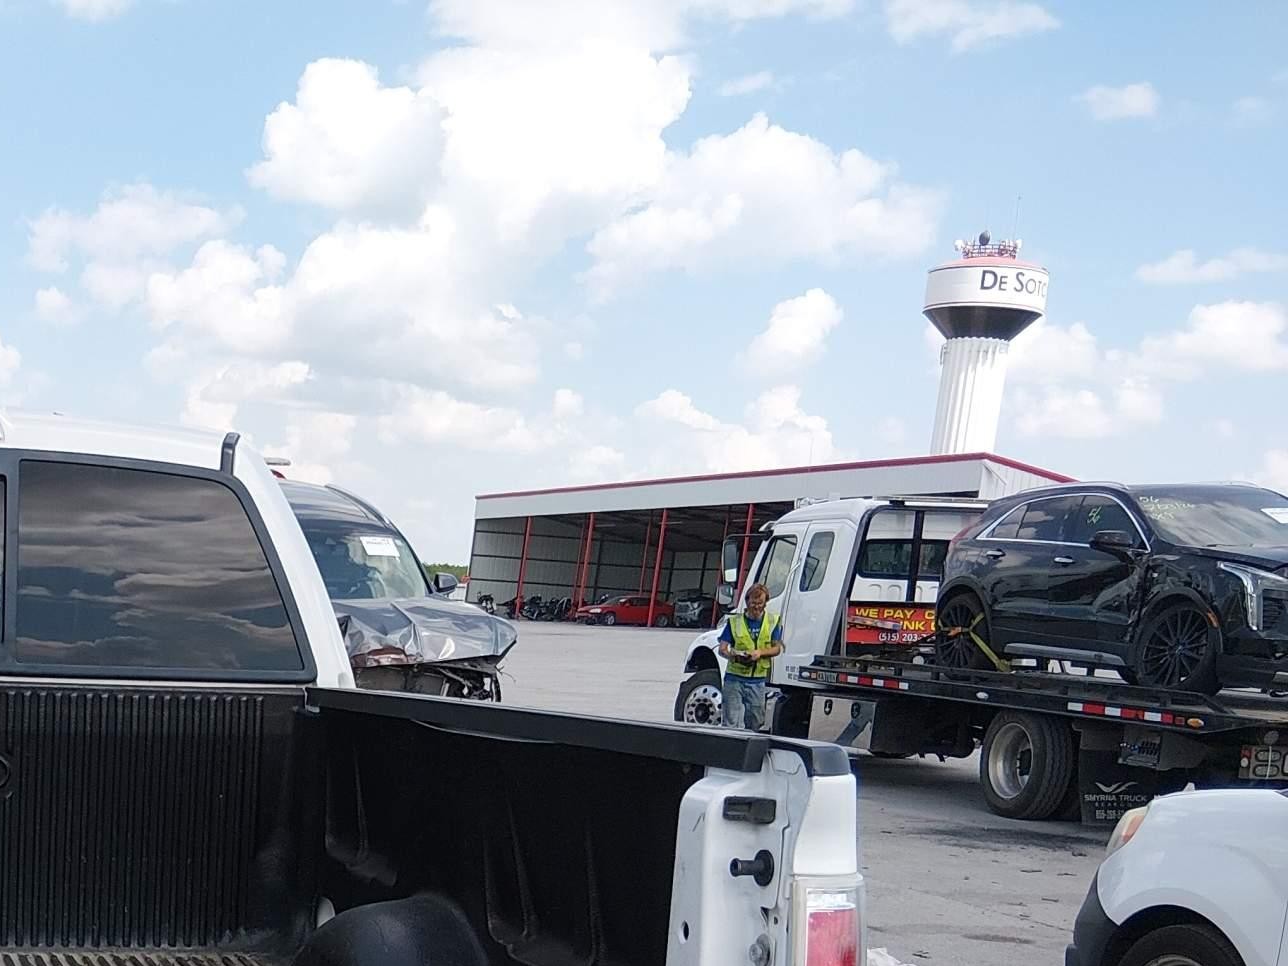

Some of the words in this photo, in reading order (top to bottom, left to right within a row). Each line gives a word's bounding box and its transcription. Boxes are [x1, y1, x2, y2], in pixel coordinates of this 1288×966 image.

[855, 608, 878, 617] WE
[884, 609, 915, 619] PAY
[878, 632, 900, 642] (515)
